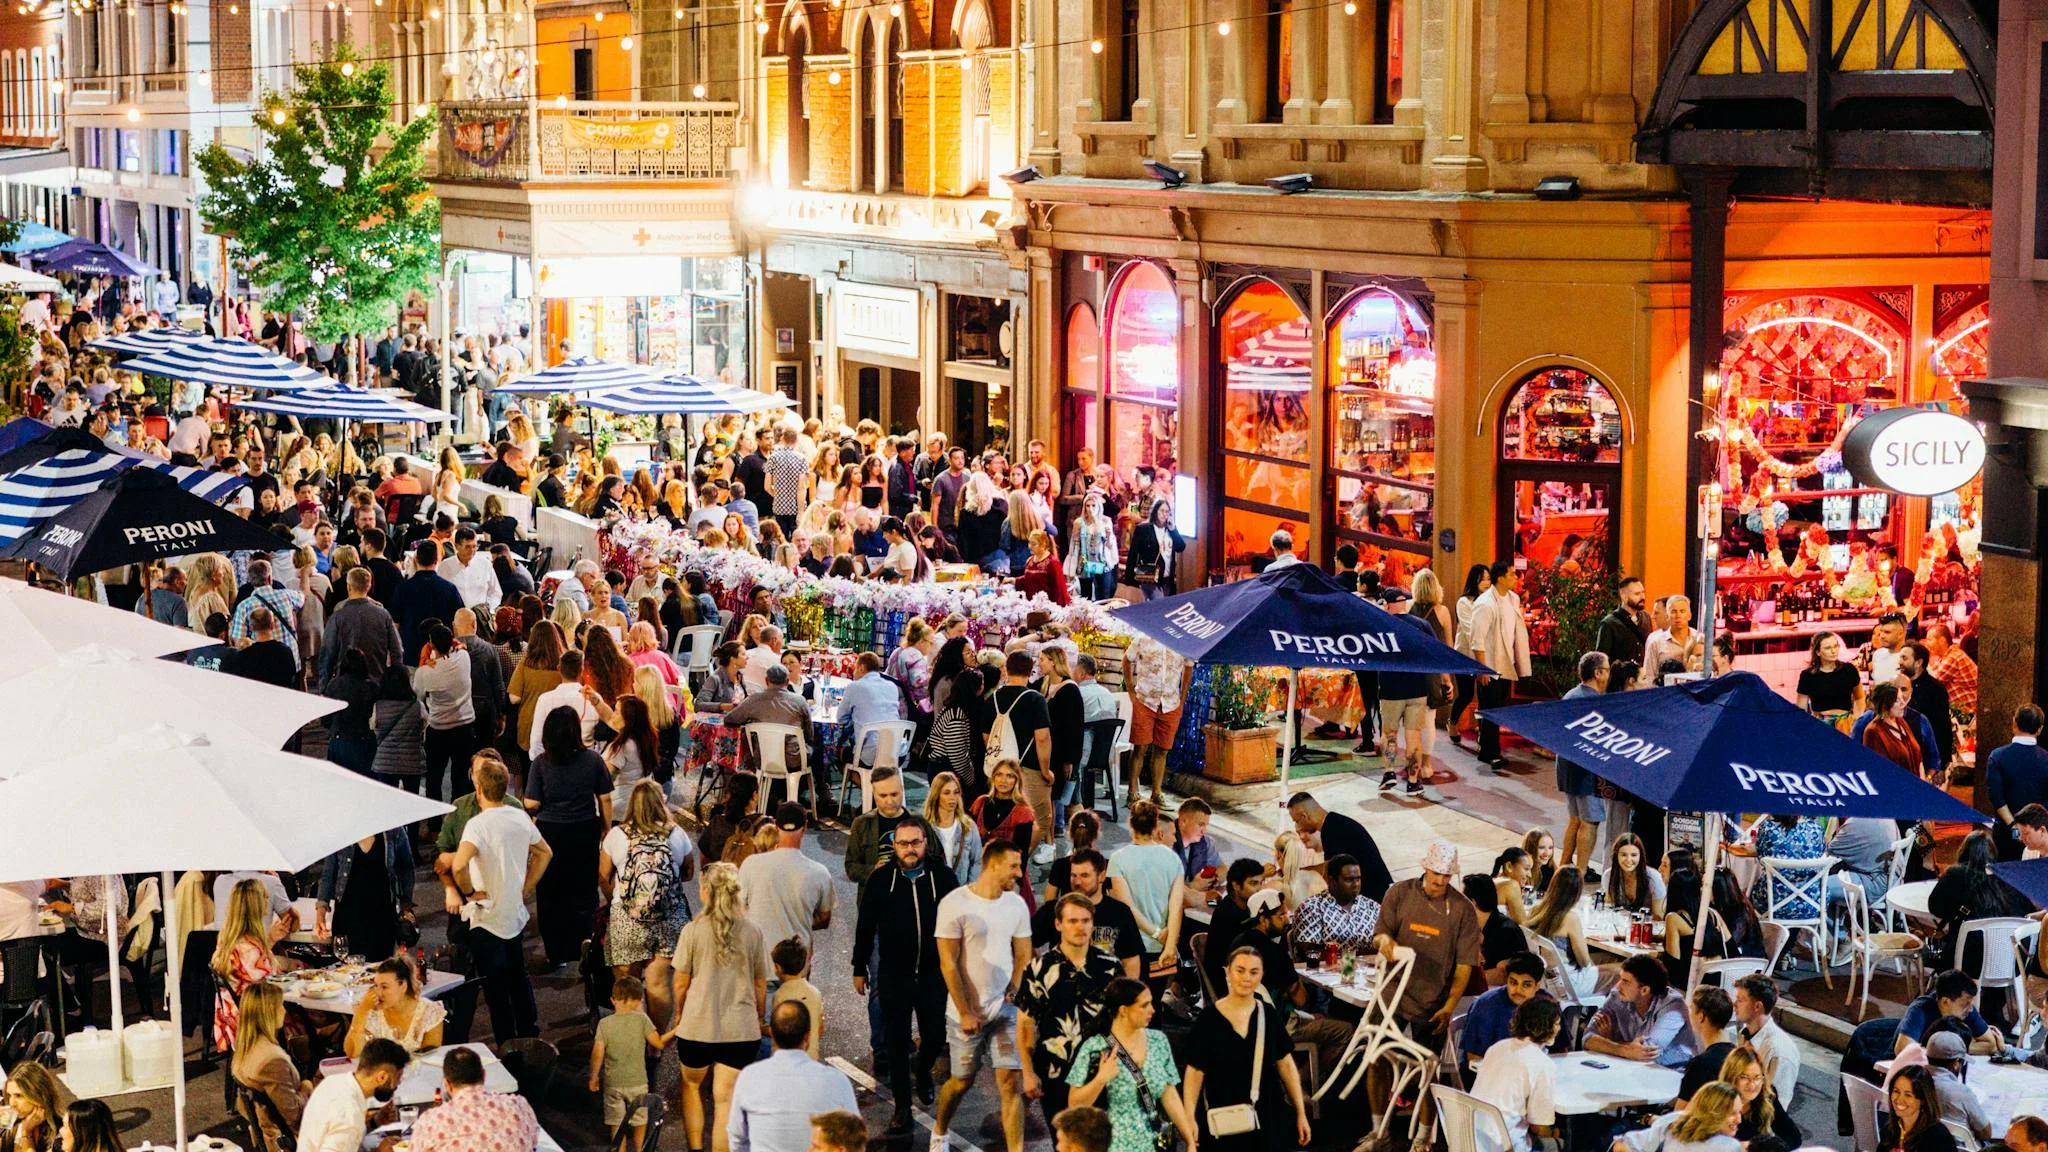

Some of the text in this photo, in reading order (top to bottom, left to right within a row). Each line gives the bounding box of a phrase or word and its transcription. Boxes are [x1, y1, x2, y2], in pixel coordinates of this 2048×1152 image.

[585, 123, 632, 136] COME
[1886, 440, 1970, 467] SICILY
[40, 524, 84, 548] PERONI
[122, 519, 217, 545] PERONI
[155, 539, 198, 553] ITALY
[1162, 625, 1184, 639] ITALIA
[1164, 601, 1226, 640] PERONI
[1268, 629, 1402, 656] PERONI
[1315, 655, 1367, 665] ITALIA
[1564, 710, 1672, 767] PERONI
[1573, 740, 1612, 762] ITALIA
[1729, 762, 1880, 797] PERONI
[1788, 796, 1846, 807] ITALIA
[1672, 816, 1699, 826] GORDON
